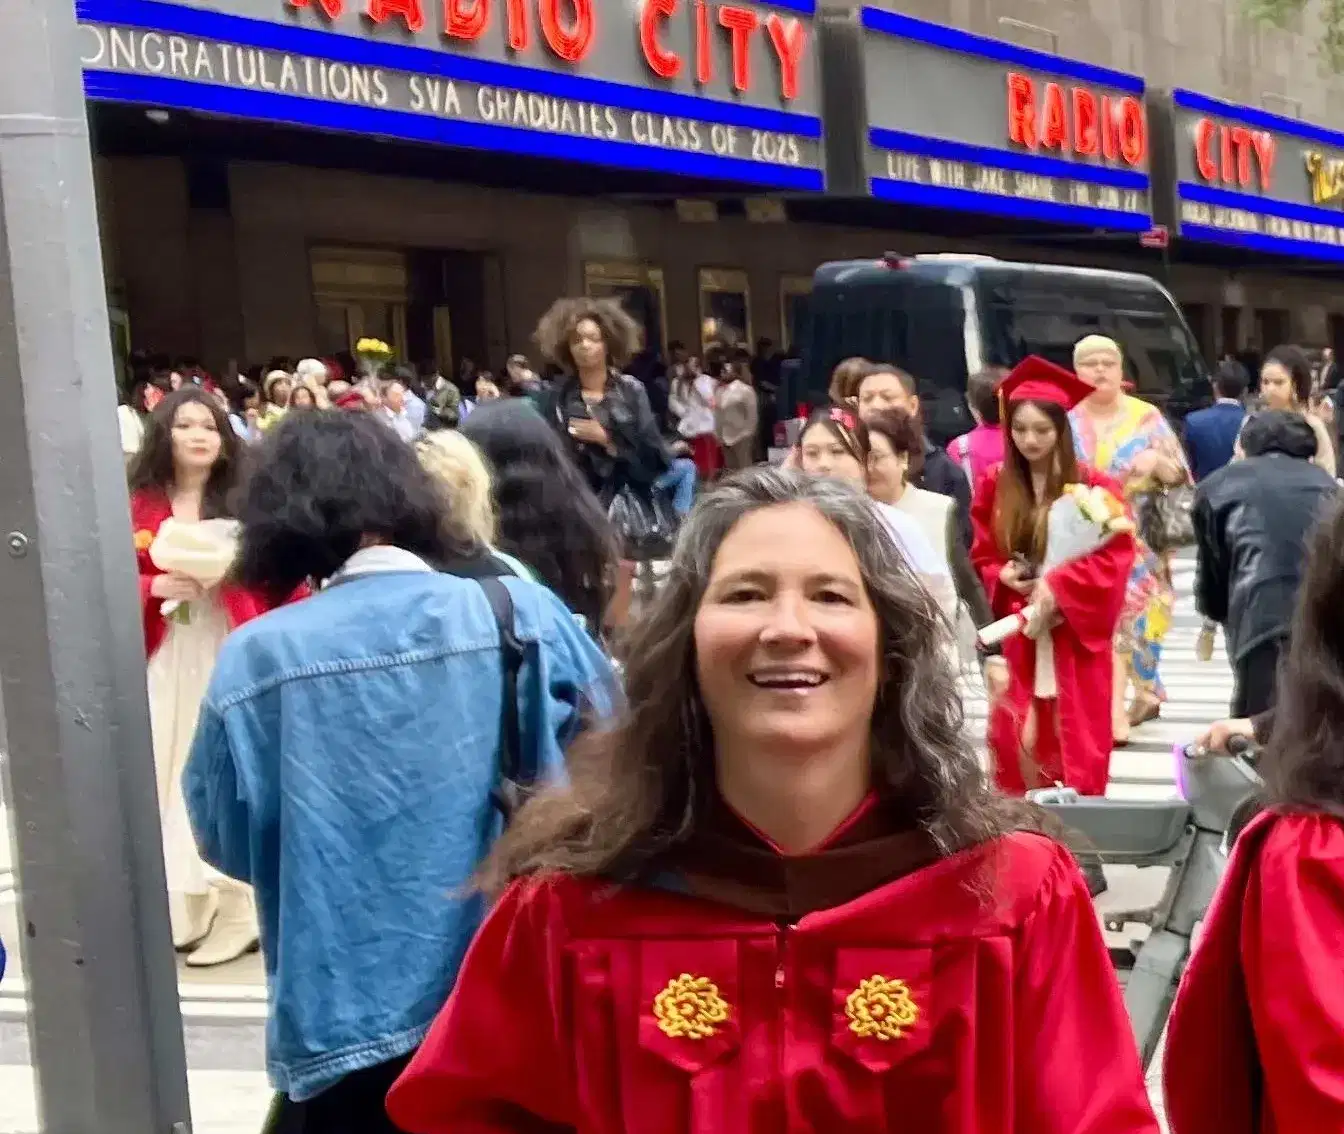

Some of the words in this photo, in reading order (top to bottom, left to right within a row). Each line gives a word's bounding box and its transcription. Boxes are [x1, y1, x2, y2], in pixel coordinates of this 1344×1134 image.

[76, 24, 389, 107] ONGRATULATIONS
[409, 76, 462, 116] SVA
[476, 86, 619, 140] GRADUATES
[630, 111, 702, 151] CLASS
[710, 123, 737, 155] OF
[751, 129, 800, 165] 2025
[640, 0, 807, 100] CITY
[1006, 71, 1146, 167] RADIO
[1194, 116, 1275, 192] CITY
